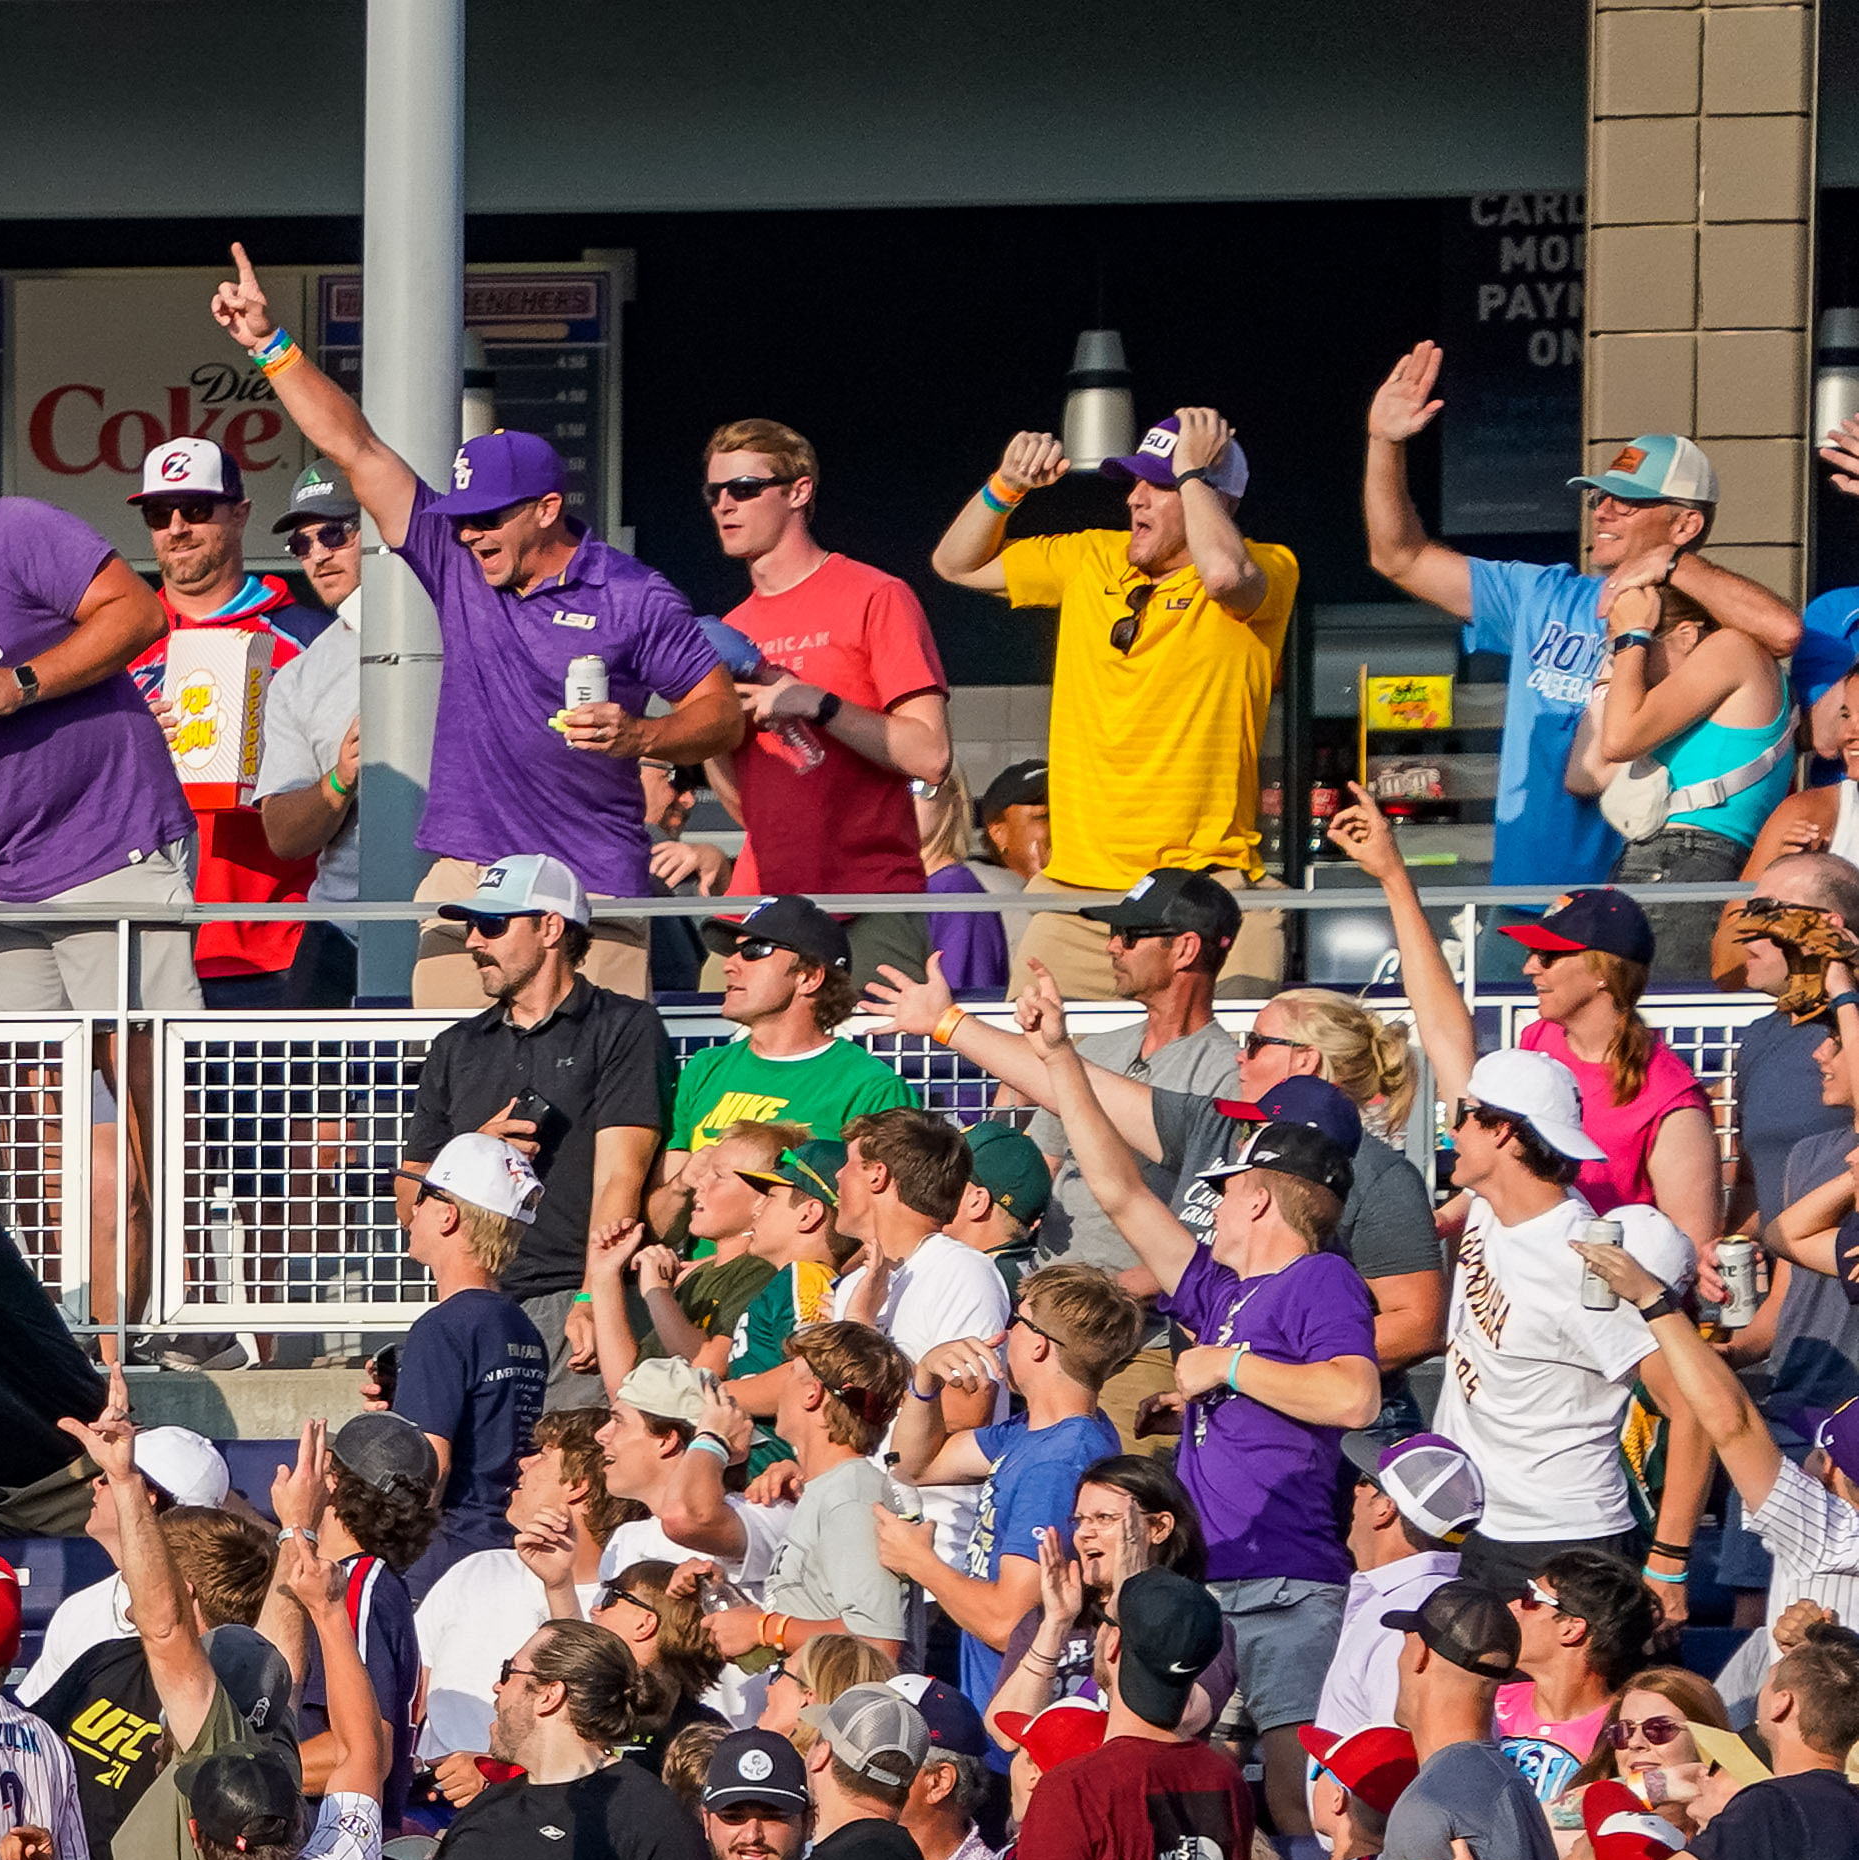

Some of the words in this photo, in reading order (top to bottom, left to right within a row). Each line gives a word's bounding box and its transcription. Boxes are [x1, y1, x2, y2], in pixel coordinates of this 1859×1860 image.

[29, 383, 284, 476] Coke
[553, 610, 597, 632] LSU
[244, 667, 262, 776] POPCORN
[715, 1092, 790, 1126] NIKE
[70, 1696, 162, 1763] UFC
